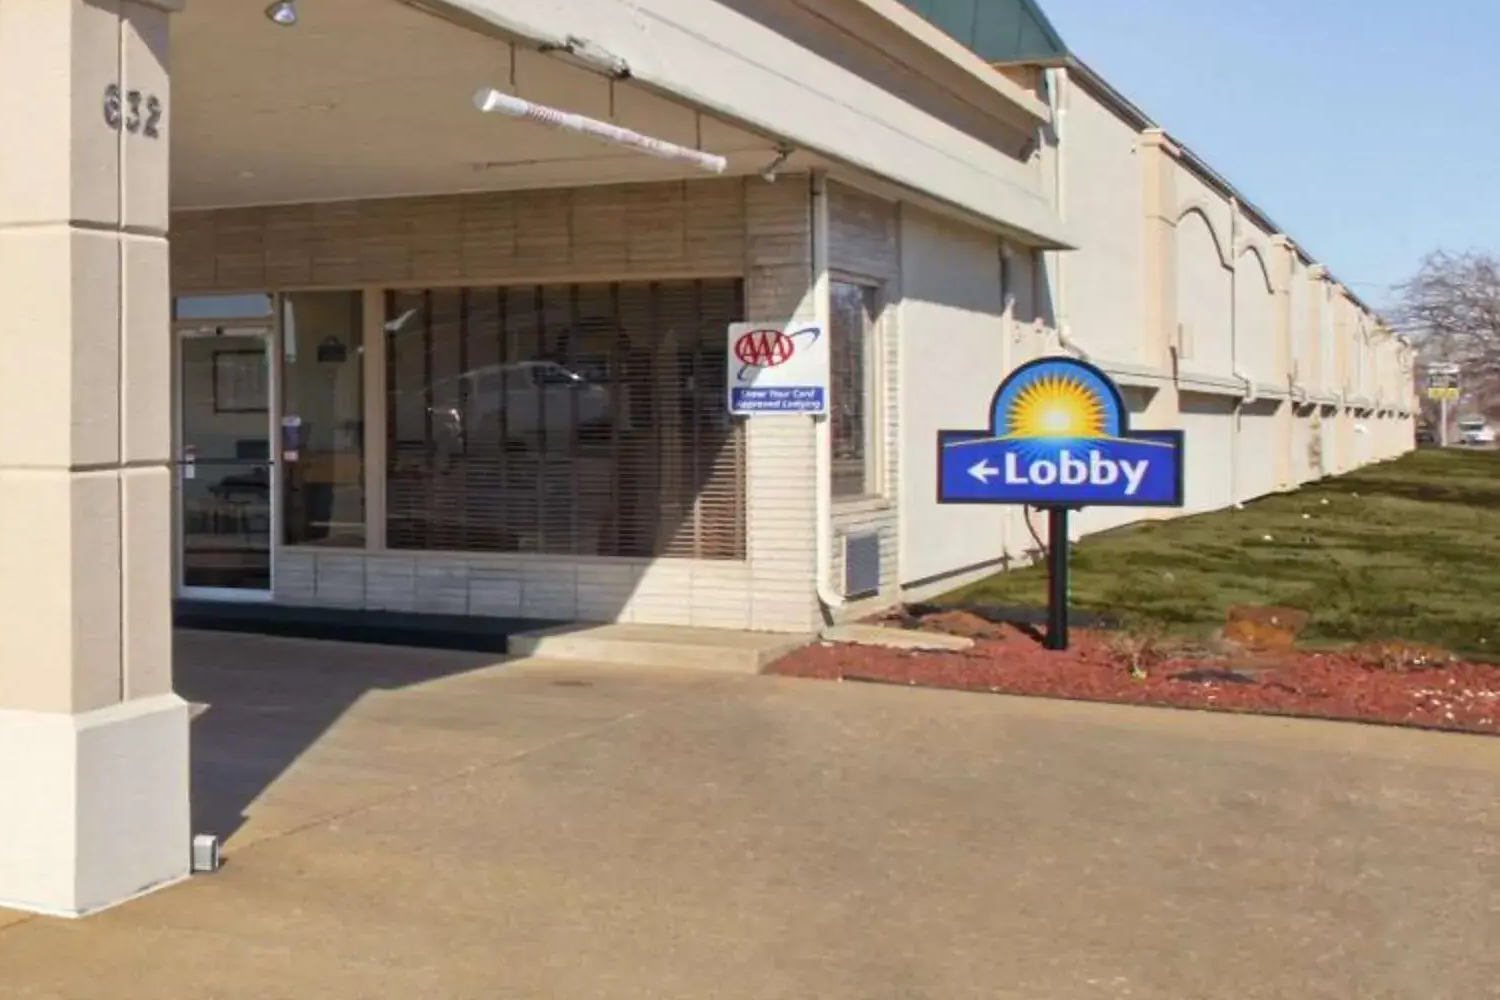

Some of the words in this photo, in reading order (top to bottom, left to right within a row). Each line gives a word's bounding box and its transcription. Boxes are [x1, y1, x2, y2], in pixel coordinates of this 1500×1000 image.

[103, 83, 162, 139] 632
[739, 329, 793, 367] AAA
[1004, 450, 1149, 495] Lobby
